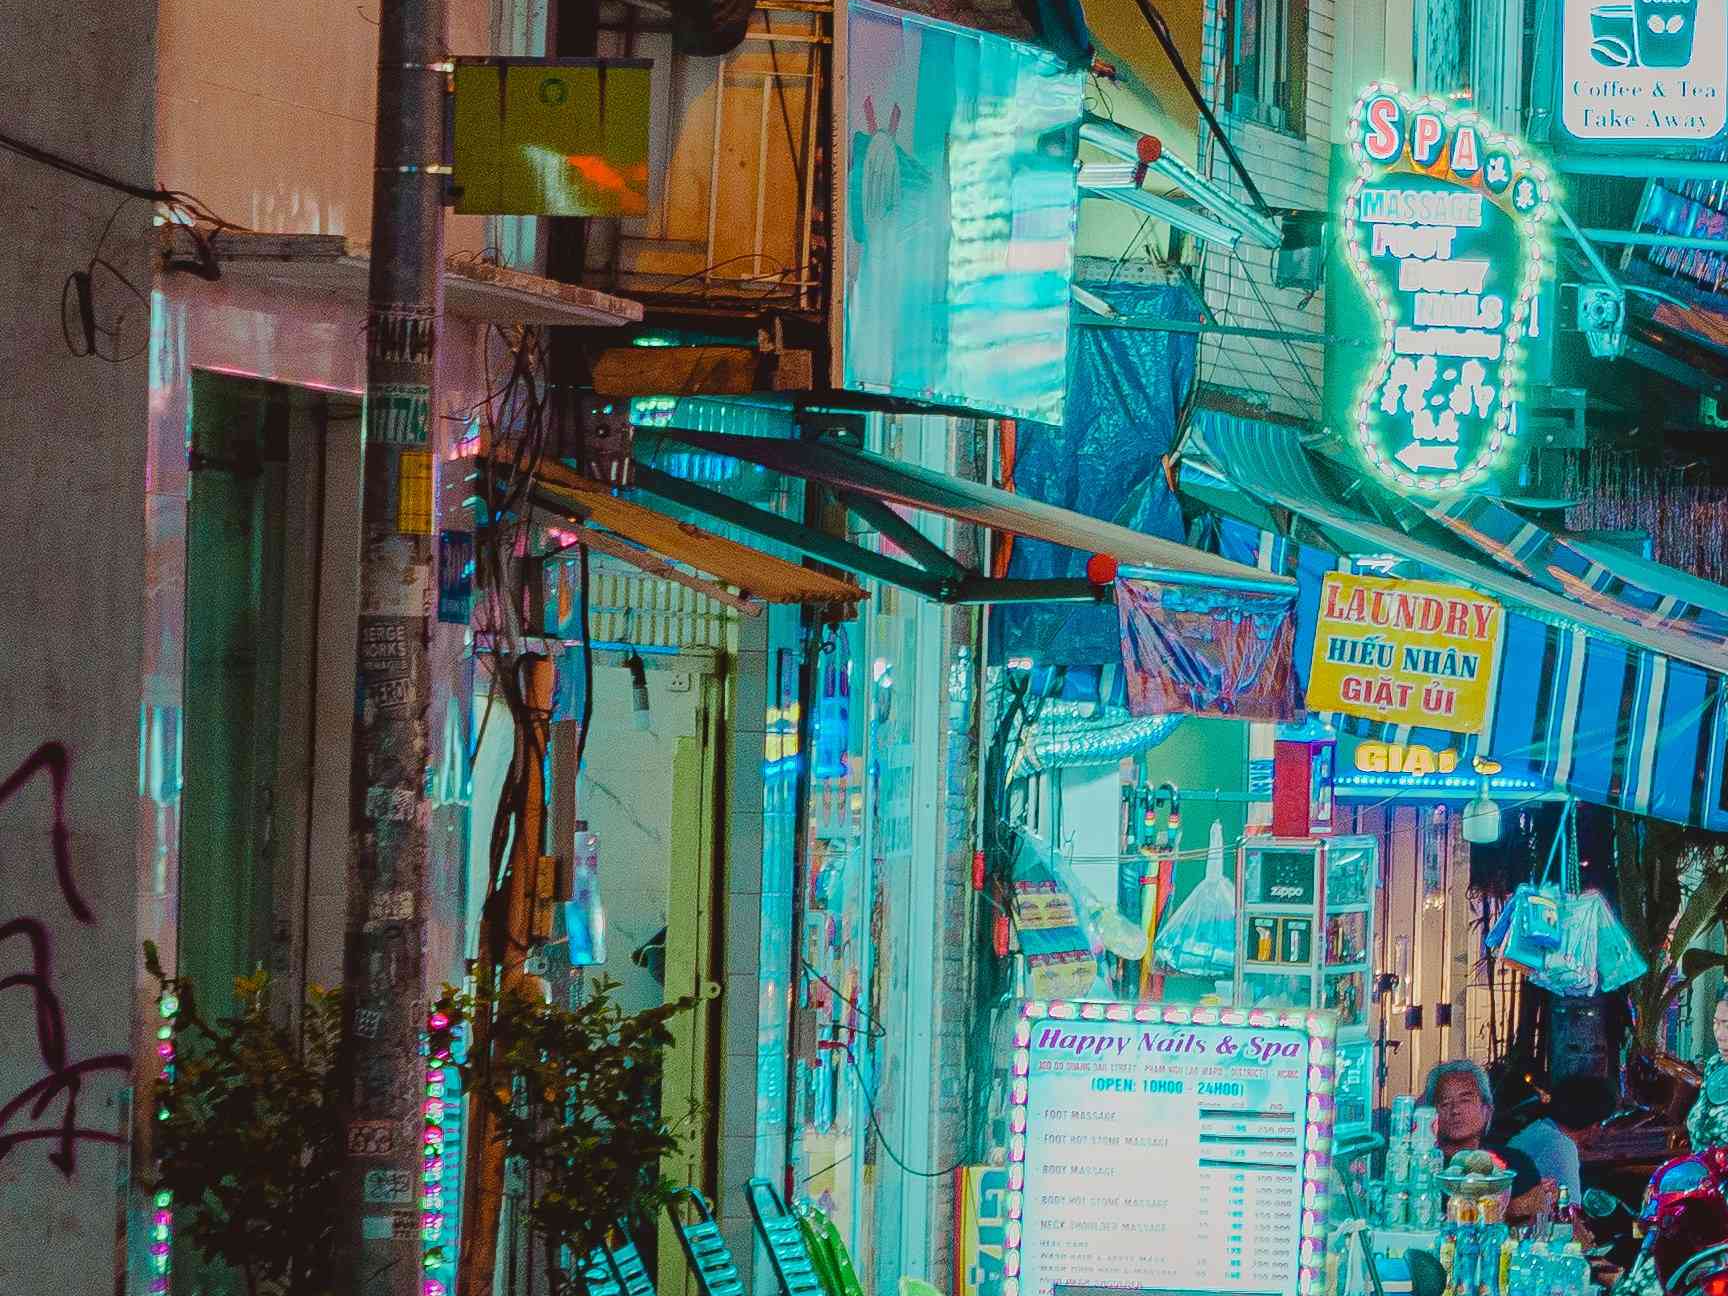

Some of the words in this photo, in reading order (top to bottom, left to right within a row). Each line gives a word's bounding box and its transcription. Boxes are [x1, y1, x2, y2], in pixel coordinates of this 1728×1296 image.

[1572, 79, 1643, 98] Coffee
[1651, 80, 1667, 98] &
[1677, 80, 1717, 98] Tea
[1365, 96, 1480, 172] SPA
[1582, 108, 1637, 128] Take
[1645, 109, 1710, 133] Away
[1324, 584, 1494, 640] LAUNDRY
[1328, 635, 1395, 669] HIẾU
[1403, 646, 1479, 679] NHÂN
[1341, 676, 1414, 711] GIẶT
[1038, 1028, 1131, 1056] Happy
[1137, 1032, 1207, 1054] Nails
[1215, 1035, 1238, 1055] &
[1247, 1036, 1300, 1062] Spa
